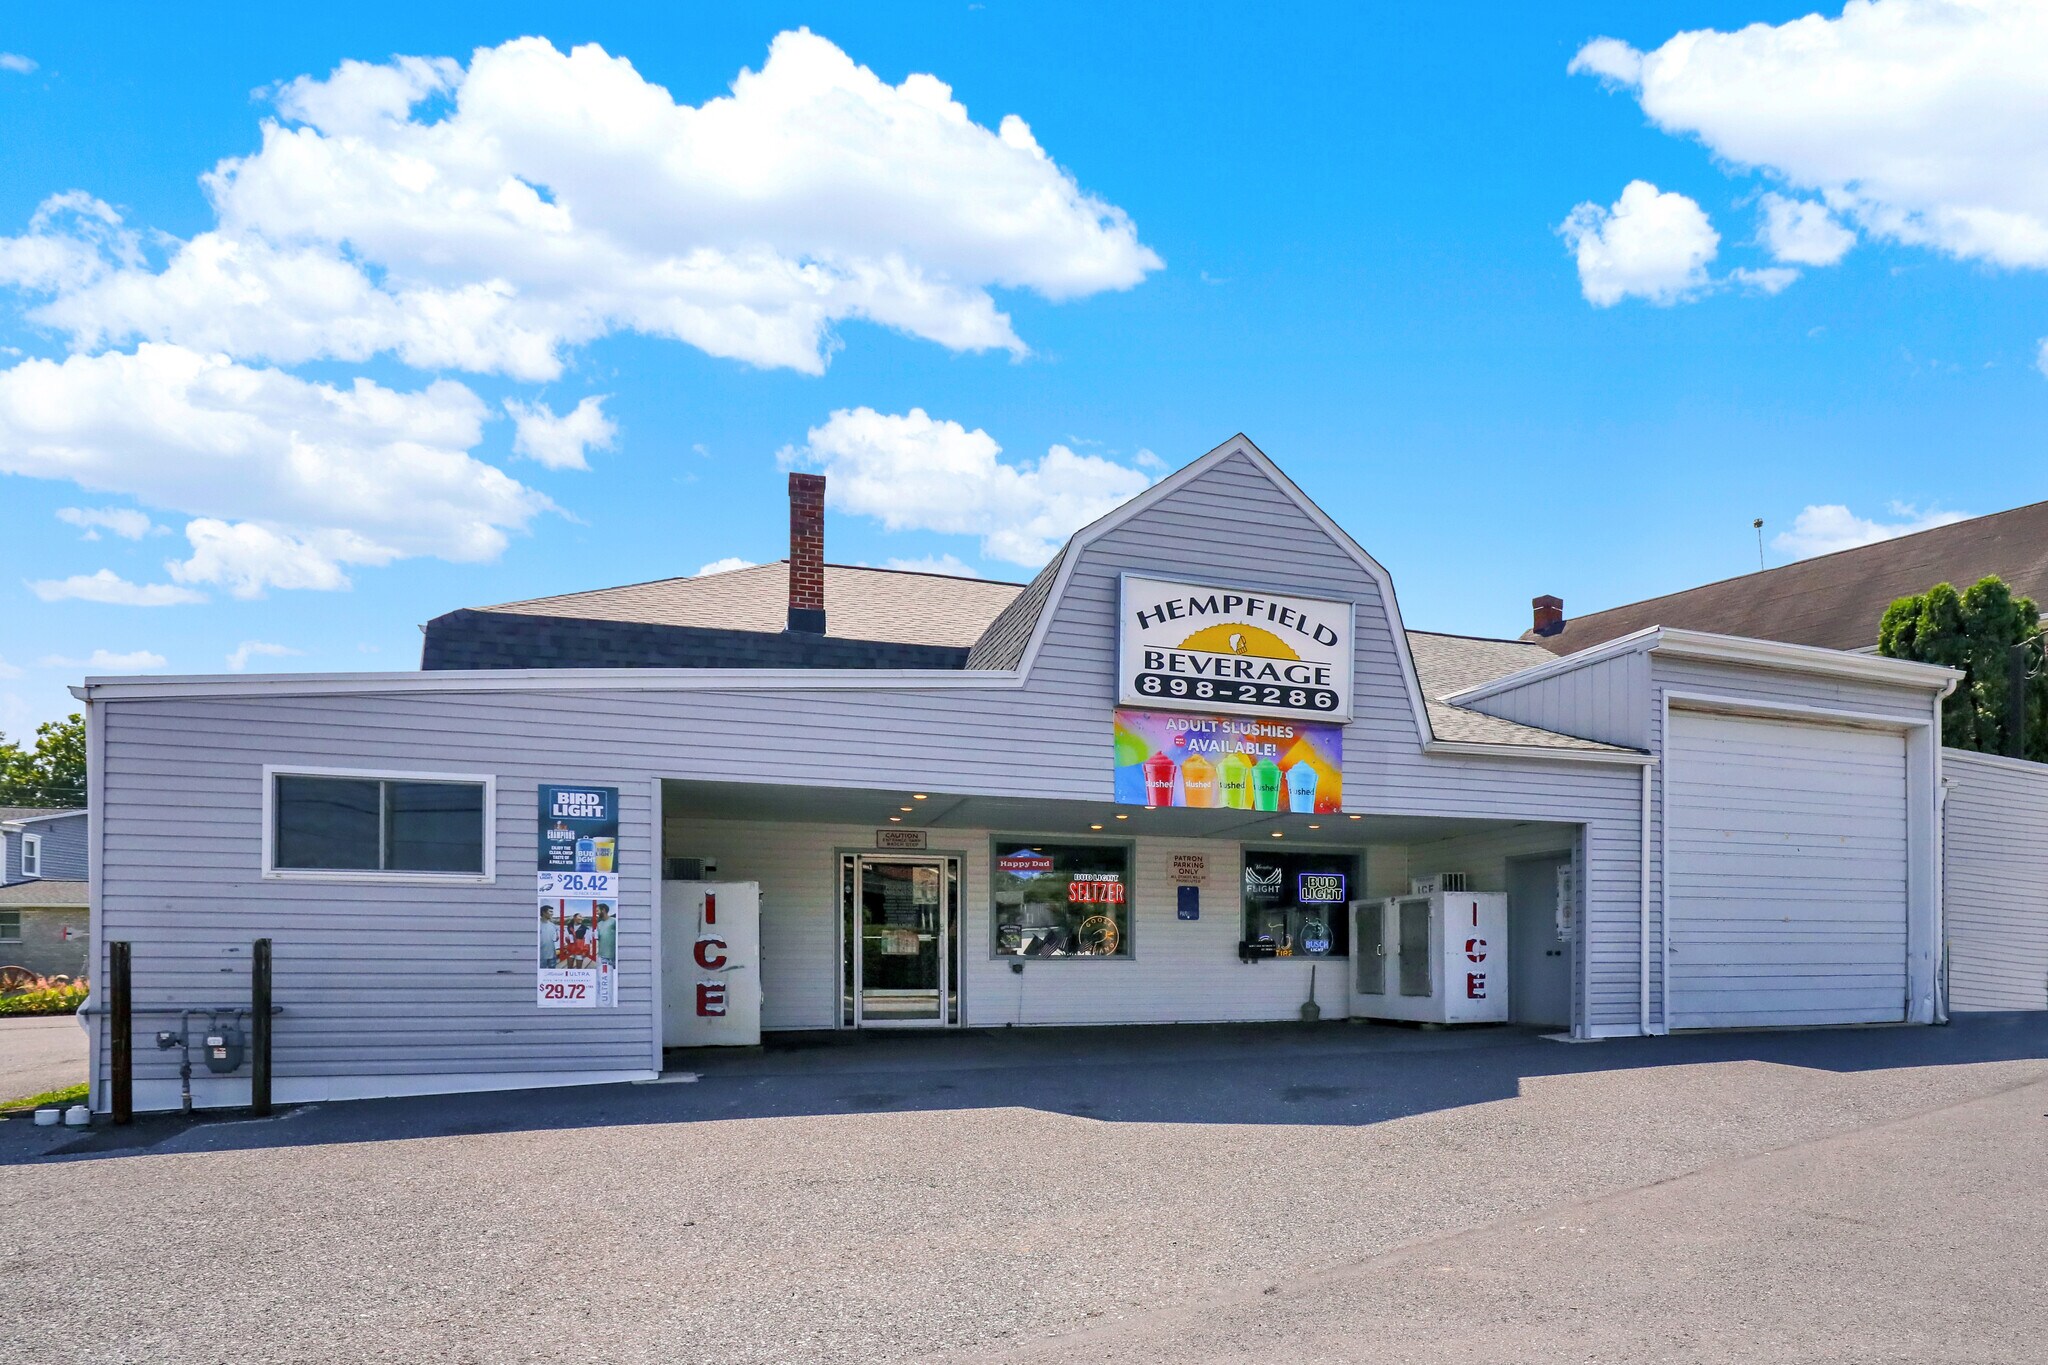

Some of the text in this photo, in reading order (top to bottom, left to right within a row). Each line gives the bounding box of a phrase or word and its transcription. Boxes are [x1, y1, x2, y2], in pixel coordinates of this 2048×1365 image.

[1136, 594, 1338, 647] HEMPFIELD
[1144, 650, 1331, 686] BEVERAGE
[1142, 676, 1332, 708] 898-2286
[1165, 718, 1294, 739] ADULT SLUSHIES
[1187, 738, 1277, 757] AVAILABLE!
[1185, 780, 1211, 788] slushed
[557, 792, 600, 805] BIRD
[553, 804, 604, 817] LIGHT
[1000, 860, 1030, 868] Happy
[1173, 861, 1204, 869] PARKING
[557, 873, 608, 890] $26.42
[1246, 884, 1280, 893] FLIGHT
[1307, 876, 1338, 888] BUD
[1069, 882, 1124, 902] SELTZER
[1302, 888, 1342, 900] LIGHT
[693, 887, 728, 1016] ICE
[1305, 940, 1329, 949] BUSCH
[1465, 901, 1487, 999] ICE
[539, 983, 586, 999] $29.72
[601, 975, 609, 1002] ULTRA
